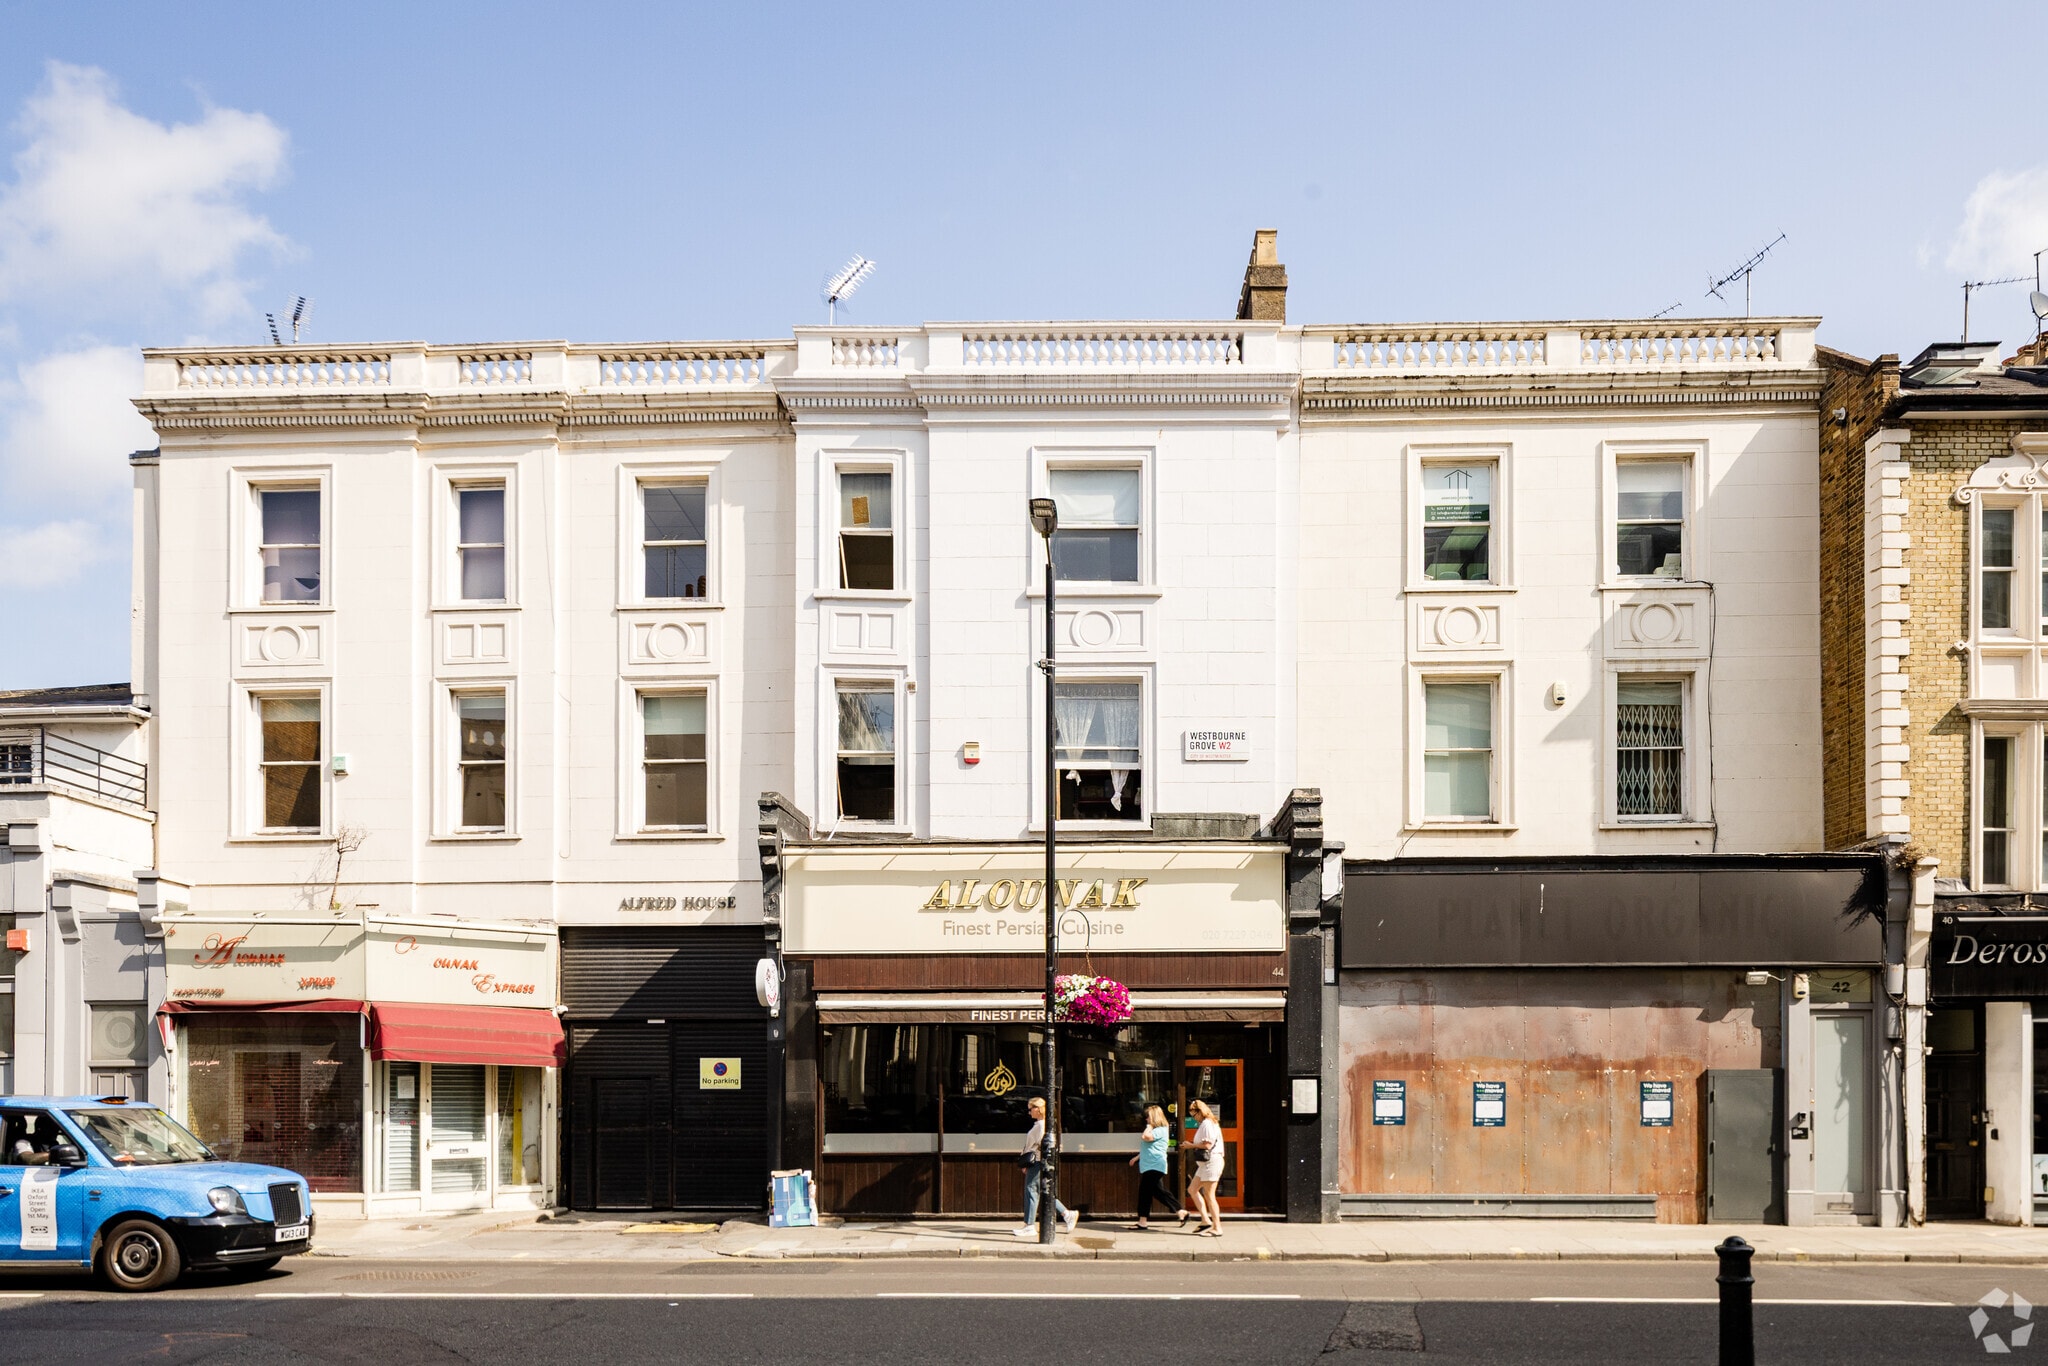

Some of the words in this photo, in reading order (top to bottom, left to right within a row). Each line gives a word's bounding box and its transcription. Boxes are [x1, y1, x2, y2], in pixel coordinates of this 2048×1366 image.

[1190, 731, 1246, 740] WESTBOURNE
[1190, 741, 1216, 750] GROVE
[1219, 741, 1231, 750] W2
[922, 878, 1149, 909] ALOUNAK
[619, 896, 677, 911] ALFRED
[683, 896, 737, 911] HOUSE
[1942, 917, 1953, 925] 40
[943, 920, 991, 936] Finest
[997, 920, 1046, 936] Persia
[1946, 935, 2048, 964] Deros
[1272, 967, 1284, 977] 44
[1831, 981, 1850, 993] 42
[971, 1010, 1016, 1021] FINEST
[714, 1077, 739, 1085] parking
